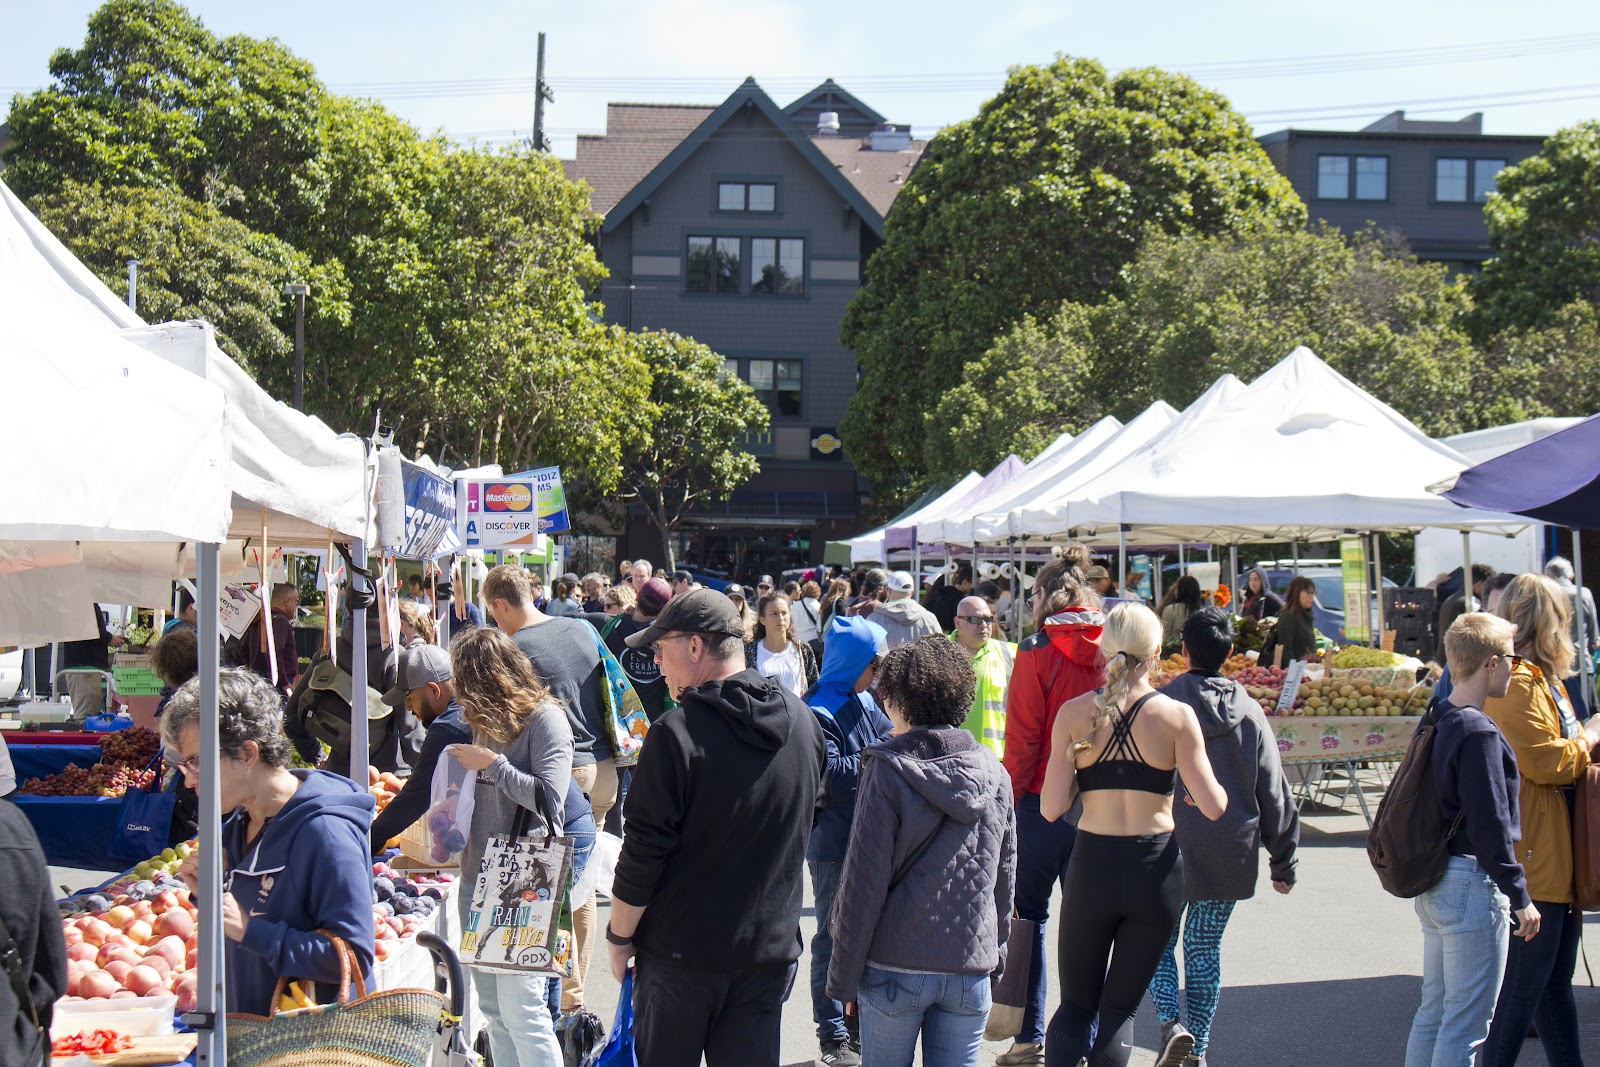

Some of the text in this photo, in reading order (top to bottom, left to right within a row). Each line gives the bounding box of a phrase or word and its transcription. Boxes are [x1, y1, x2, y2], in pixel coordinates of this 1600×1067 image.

[538, 482, 552, 492] MS
[486, 493, 530, 502] MasterCard
[485, 522, 530, 530] DISCOVER
[220, 597, 240, 615] rapes
[493, 906, 529, 926] RAIN
[522, 953, 547, 964] PDX
